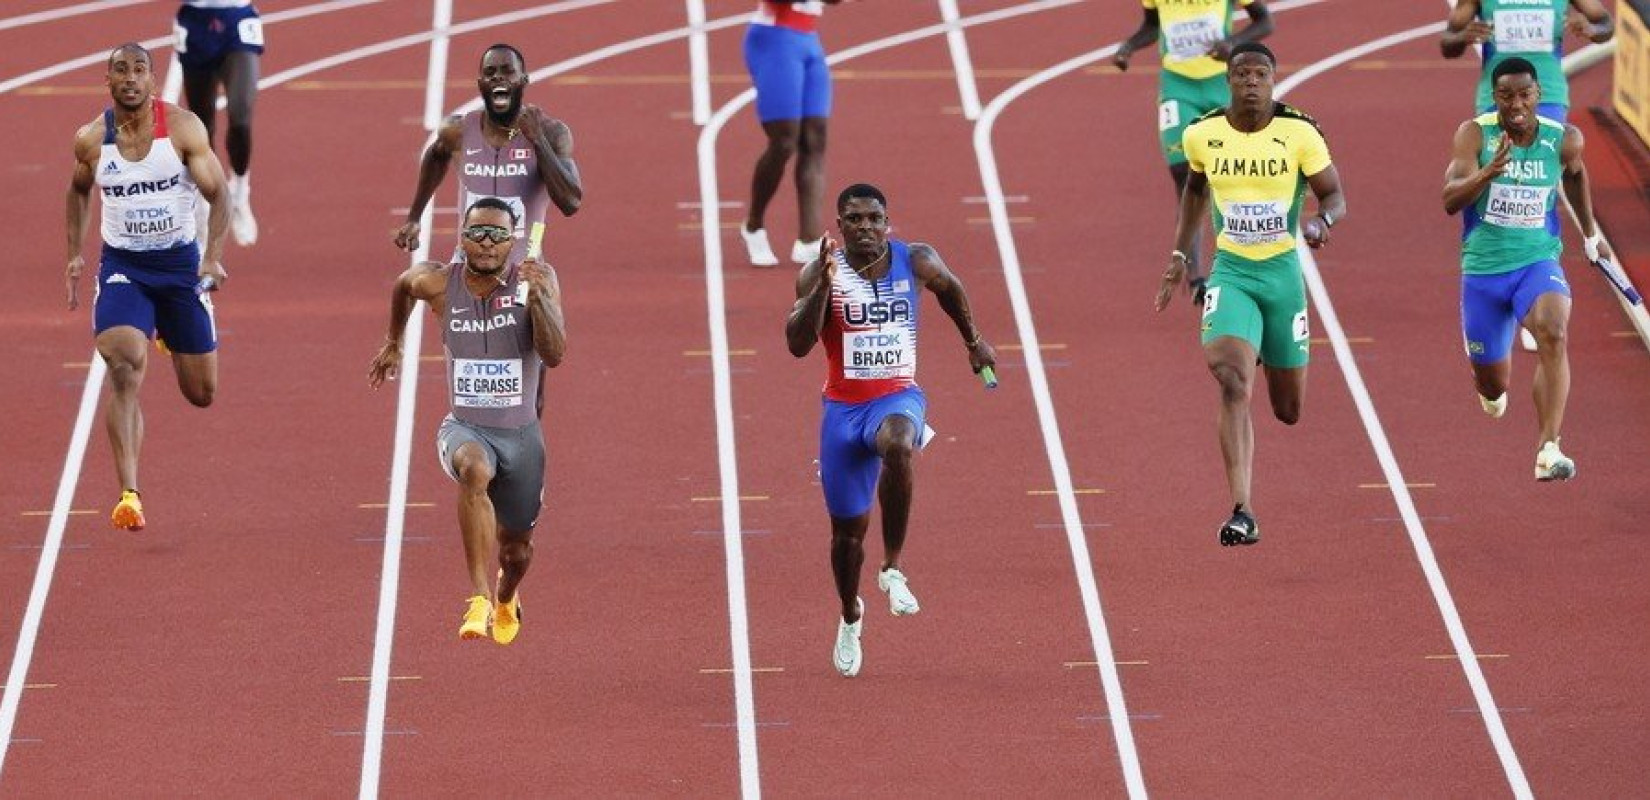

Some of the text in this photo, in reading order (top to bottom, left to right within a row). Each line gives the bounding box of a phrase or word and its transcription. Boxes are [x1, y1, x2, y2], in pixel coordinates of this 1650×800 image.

[1505, 26, 1544, 39] SILVA
[464, 163, 528, 177] CANADA
[1211, 157, 1289, 177] JAMAICA
[1503, 160, 1548, 179] RASIL
[102, 174, 180, 198] FRANCE
[135, 206, 170, 218] TDK
[1239, 203, 1277, 216] TDK
[1490, 199, 1544, 217] CARDOSO
[124, 216, 174, 234] VICAUT
[1227, 216, 1284, 233] WALKER
[844, 299, 909, 325] USA
[449, 313, 517, 333] CANADA
[864, 334, 902, 347] TDK
[853, 350, 902, 365] BRACY
[473, 363, 512, 376] TDK
[457, 377, 519, 393] DE GRASSE
